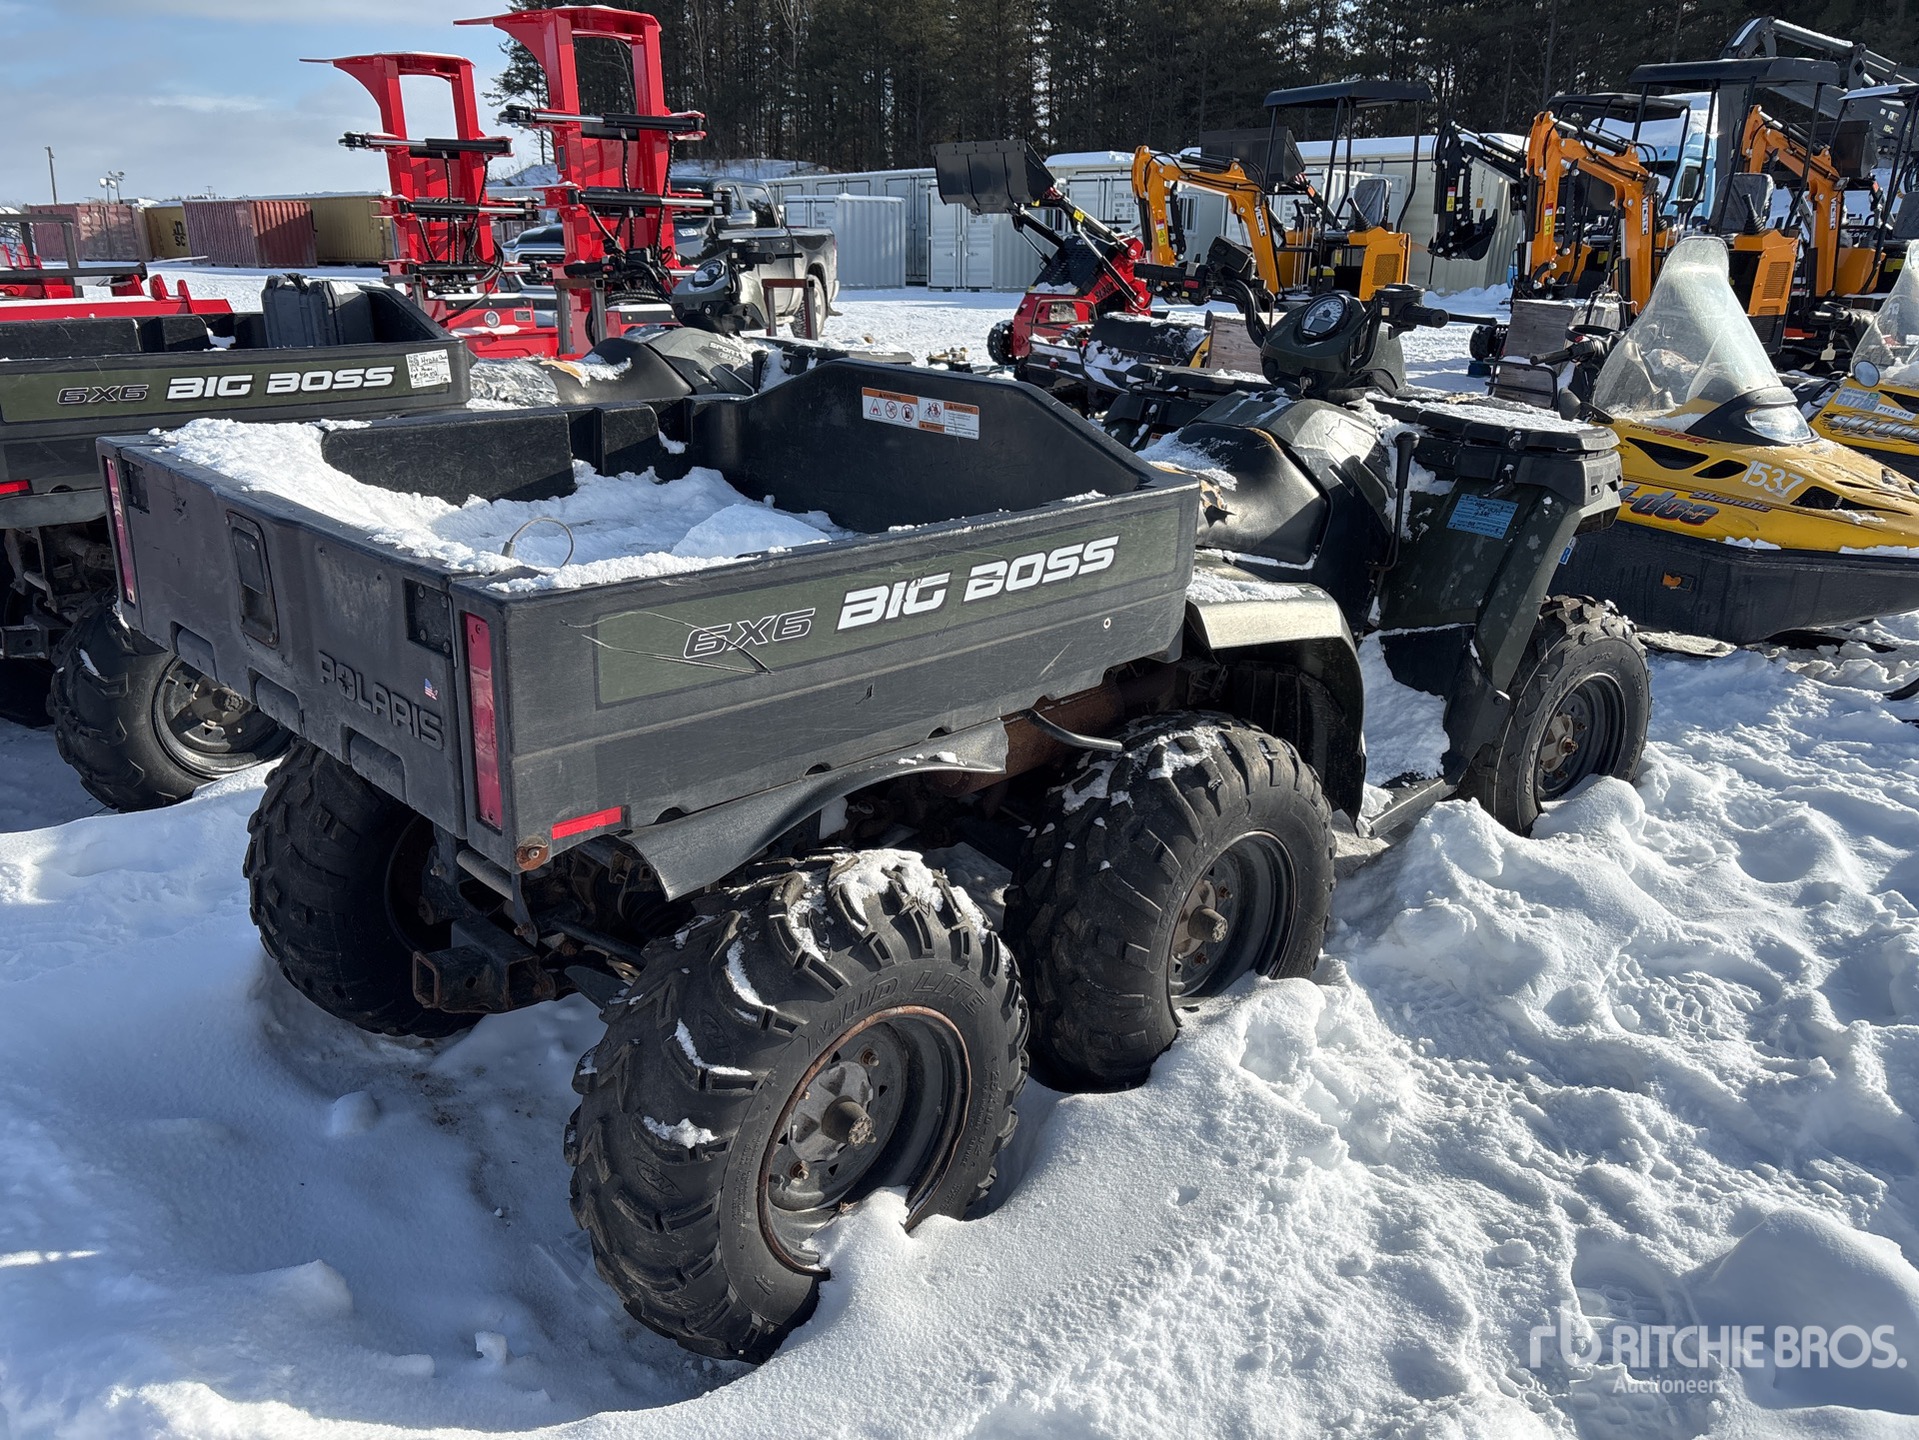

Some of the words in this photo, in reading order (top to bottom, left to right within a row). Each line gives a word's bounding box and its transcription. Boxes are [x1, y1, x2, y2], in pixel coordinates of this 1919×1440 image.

[57, 384, 149, 405] 6X6
[166, 374, 254, 401] BIG
[266, 366, 395, 394] BOSS
[1742, 459, 1806, 499] 1537
[681, 607, 817, 660] 6X6
[836, 571, 953, 632] BIG
[963, 535, 1119, 603] BOSS
[318, 650, 444, 750] POLARIS
[912, 969, 989, 1017] LITE
